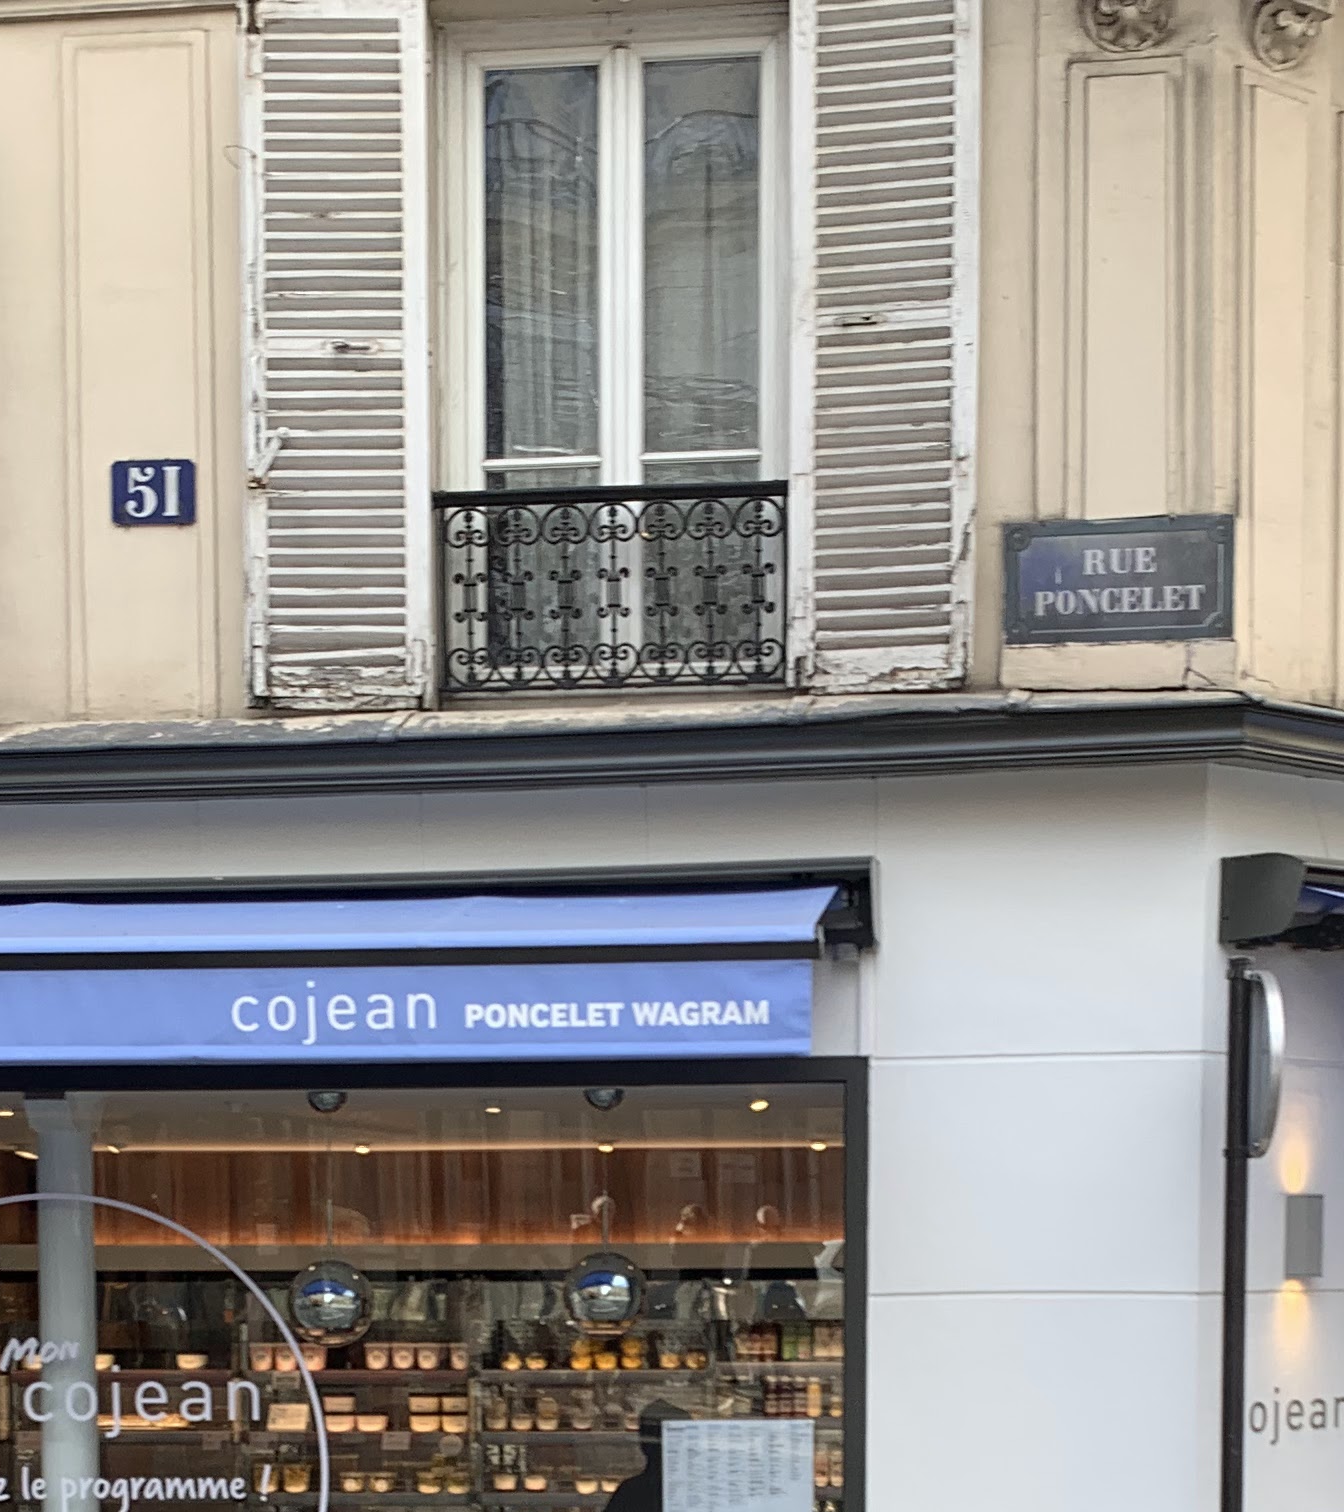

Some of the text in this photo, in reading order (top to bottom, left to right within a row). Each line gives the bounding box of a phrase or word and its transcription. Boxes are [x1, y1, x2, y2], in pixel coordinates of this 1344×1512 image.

[124, 465, 182, 518] 51
[1081, 546, 1158, 576] RUE
[1033, 584, 1206, 617] PONCELET
[231, 980, 770, 1046] cojean PONCELET WAGRAM
[22, 1364, 262, 1439] cojean
[21, 1466, 47, 1499] le
